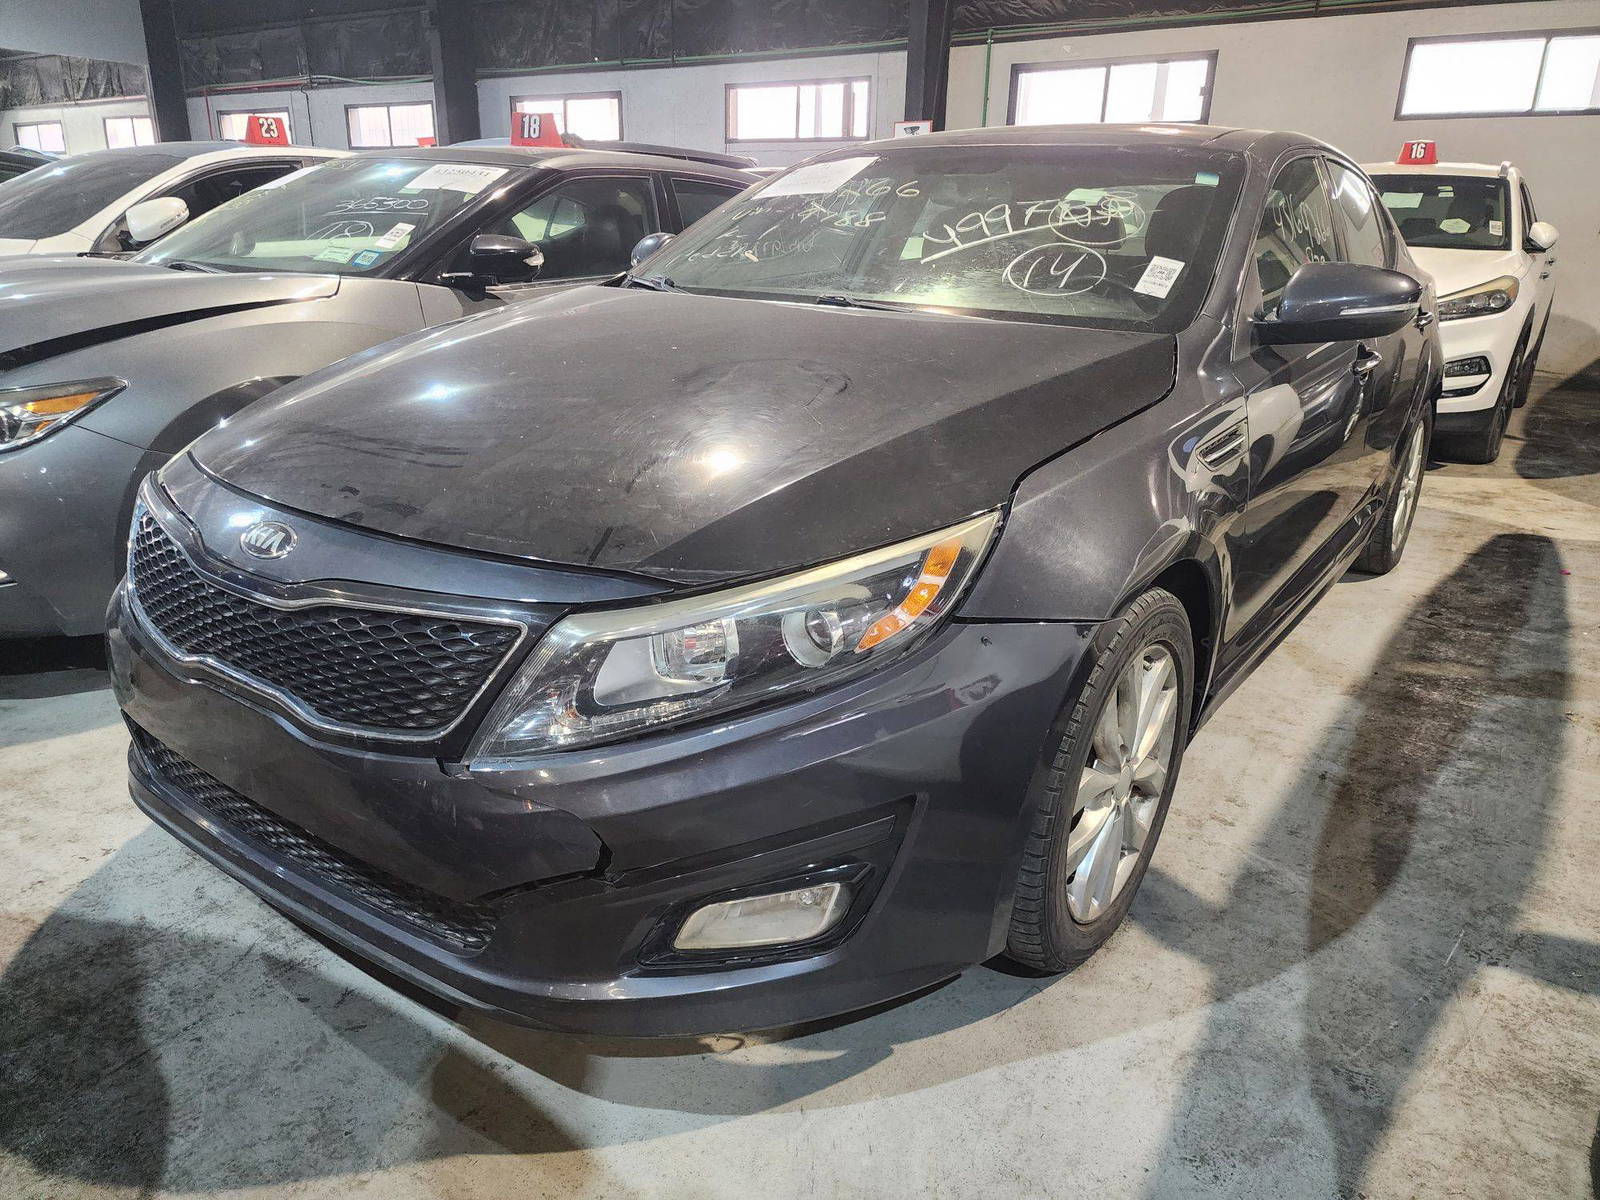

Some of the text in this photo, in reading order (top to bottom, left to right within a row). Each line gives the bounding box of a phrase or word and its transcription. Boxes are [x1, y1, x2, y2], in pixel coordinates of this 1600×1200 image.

[258, 117, 279, 138] 23
[522, 113, 541, 138] 18
[1410, 142, 1426, 159] 16
[1023, 251, 1090, 288] 14
